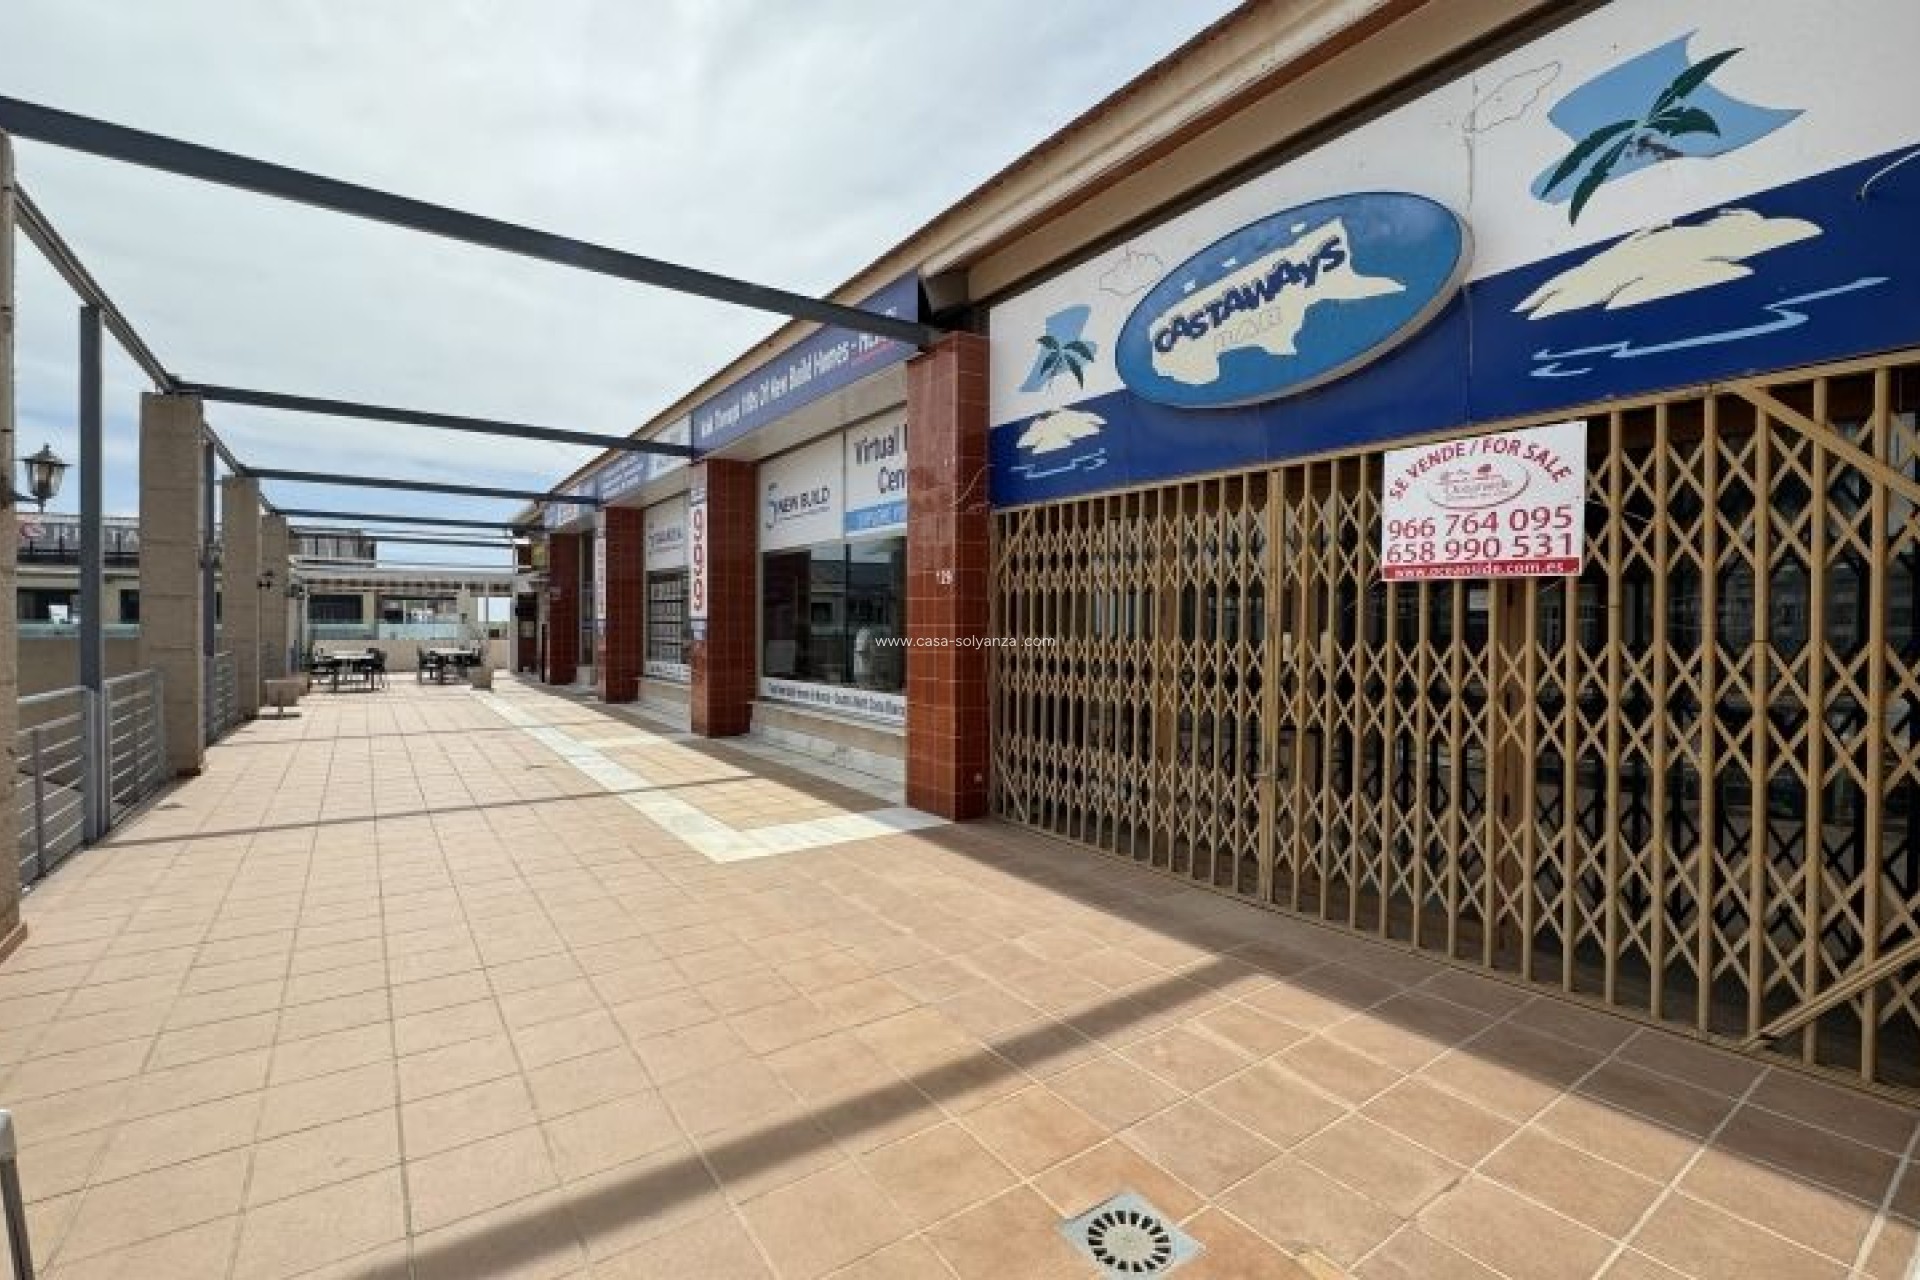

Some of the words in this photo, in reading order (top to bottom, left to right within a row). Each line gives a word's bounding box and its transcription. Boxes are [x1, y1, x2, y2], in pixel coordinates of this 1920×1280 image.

[789, 353, 812, 391] Build
[813, 340, 849, 378] Homes
[854, 425, 900, 465] Virtual
[1389, 476, 1409, 500] SE
[1405, 442, 1466, 478] VENDE
[1482, 436, 1521, 457] FOR
[1522, 442, 1572, 484] SALE
[779, 495, 799, 513] NEW
[800, 485, 831, 508] BUILD
[1386, 516, 1436, 541] 966
[1445, 511, 1500, 537] 764
[1509, 504, 1573, 532] 095
[1386, 541, 1436, 564] 658
[1445, 538, 1500, 561] 990
[1512, 533, 1573, 559] 531
